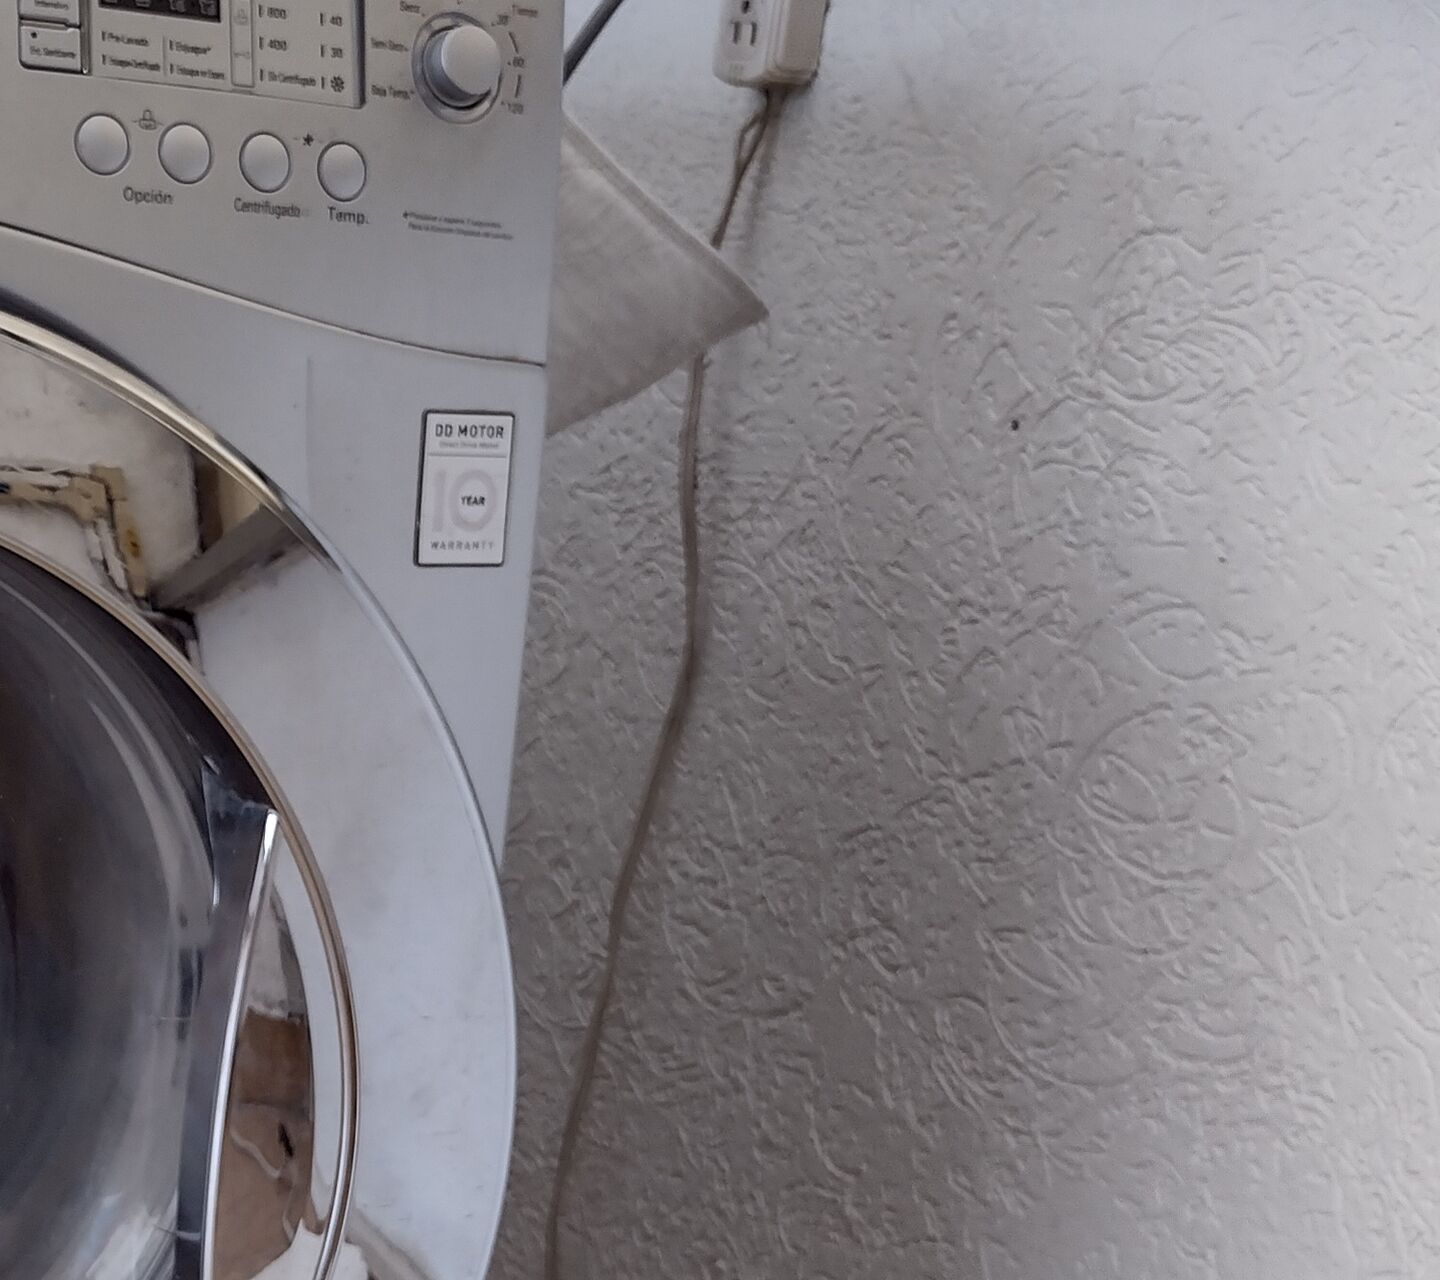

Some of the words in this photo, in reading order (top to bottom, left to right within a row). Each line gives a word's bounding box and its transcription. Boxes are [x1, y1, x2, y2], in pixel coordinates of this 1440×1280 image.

[123, 186, 174, 205] Opción
[233, 197, 301, 219] Centrifugado
[327, 206, 370, 225] Temp.
[435, 424, 453, 438] DD
[457, 424, 504, 439] MOTOR
[461, 496, 486, 506] YEAR
[430, 540, 494, 551] WARRANTY
